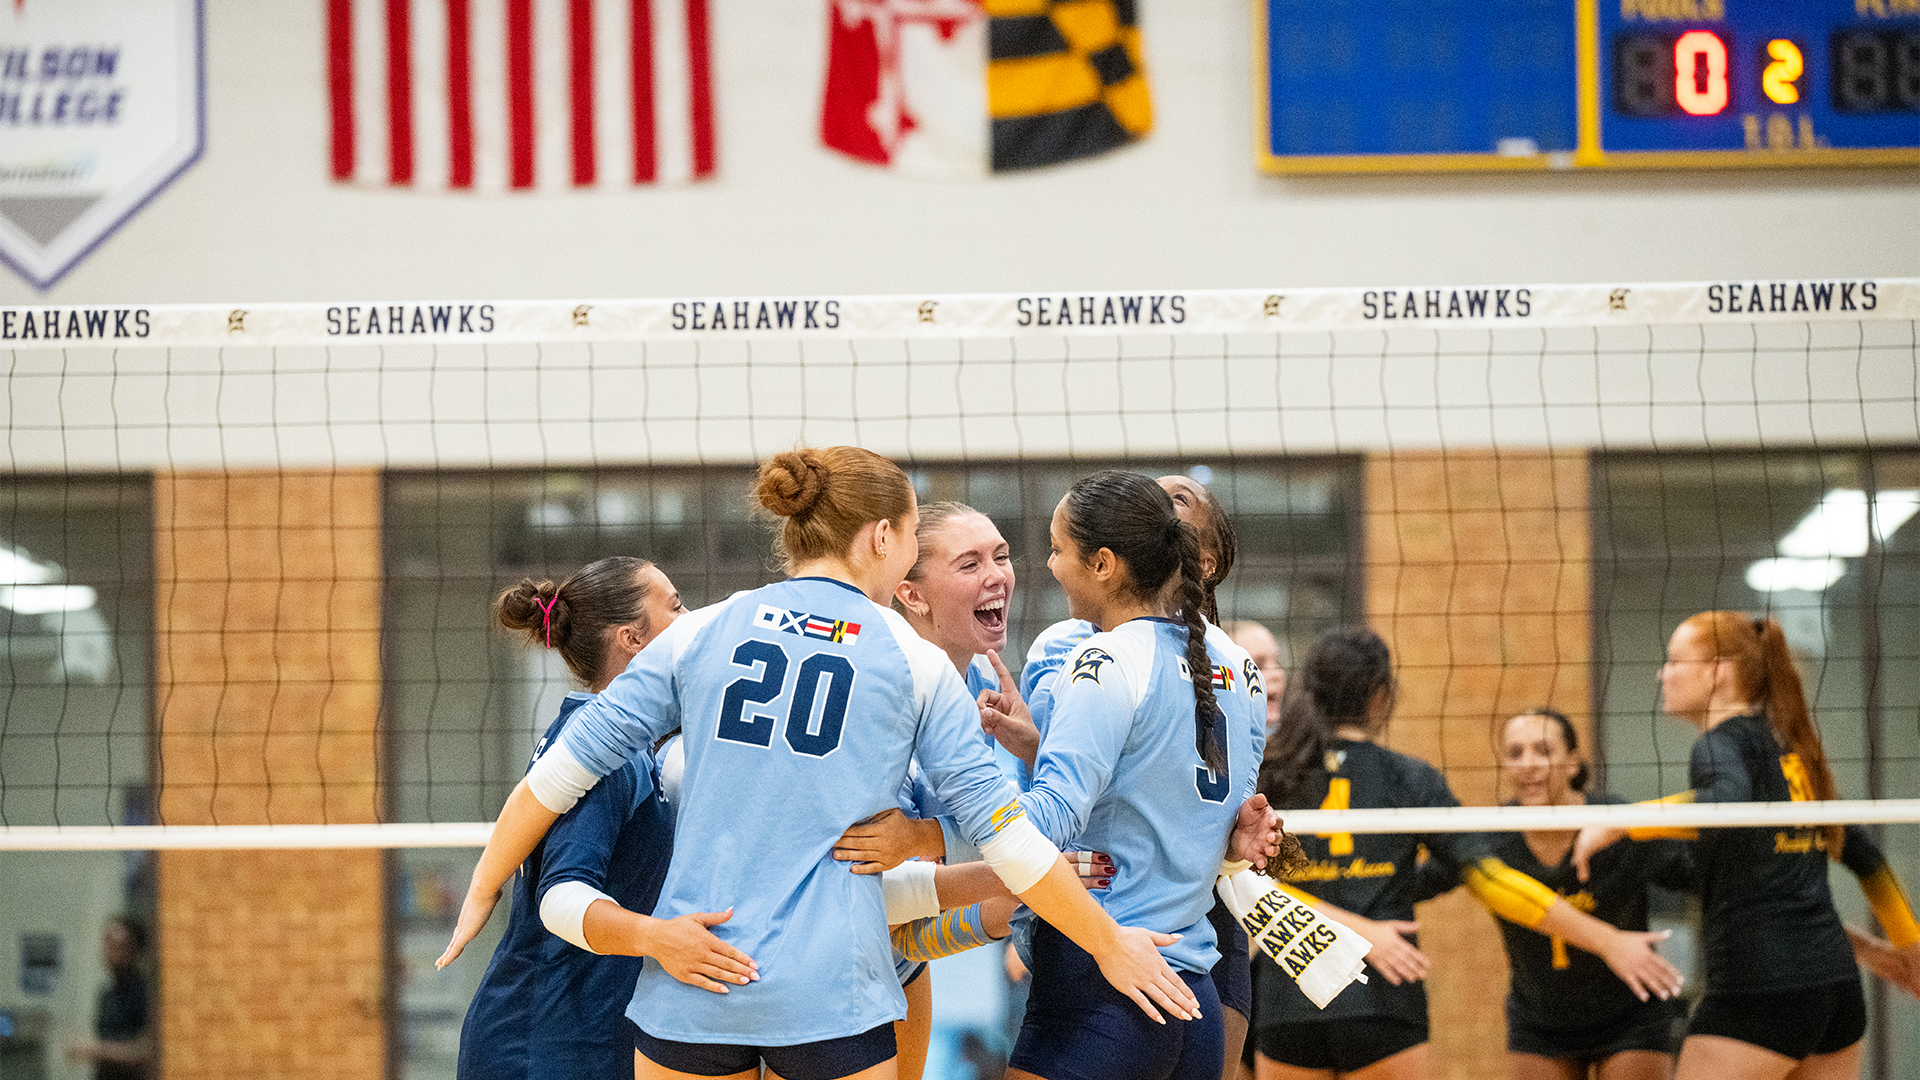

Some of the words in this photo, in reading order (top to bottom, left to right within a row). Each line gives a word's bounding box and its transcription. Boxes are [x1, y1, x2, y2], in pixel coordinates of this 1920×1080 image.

[0, 47, 120, 80] ILSON
[1674, 29, 1728, 116] 0
[1762, 38, 1803, 104] 2
[2, 309, 151, 339] EAHAWKS
[327, 305, 495, 335] SEAHAWKS
[672, 300, 840, 330] SEAHAWKS
[1017, 296, 1186, 326] SEAHAWKS
[1363, 289, 1531, 319] SEAHAWKS
[1708, 282, 1877, 313] SEAHAWKS
[714, 637, 858, 760] 20
[1241, 889, 1292, 938] AWKS
[1261, 904, 1316, 959] AWKS
[1283, 923, 1338, 977] AWKS
